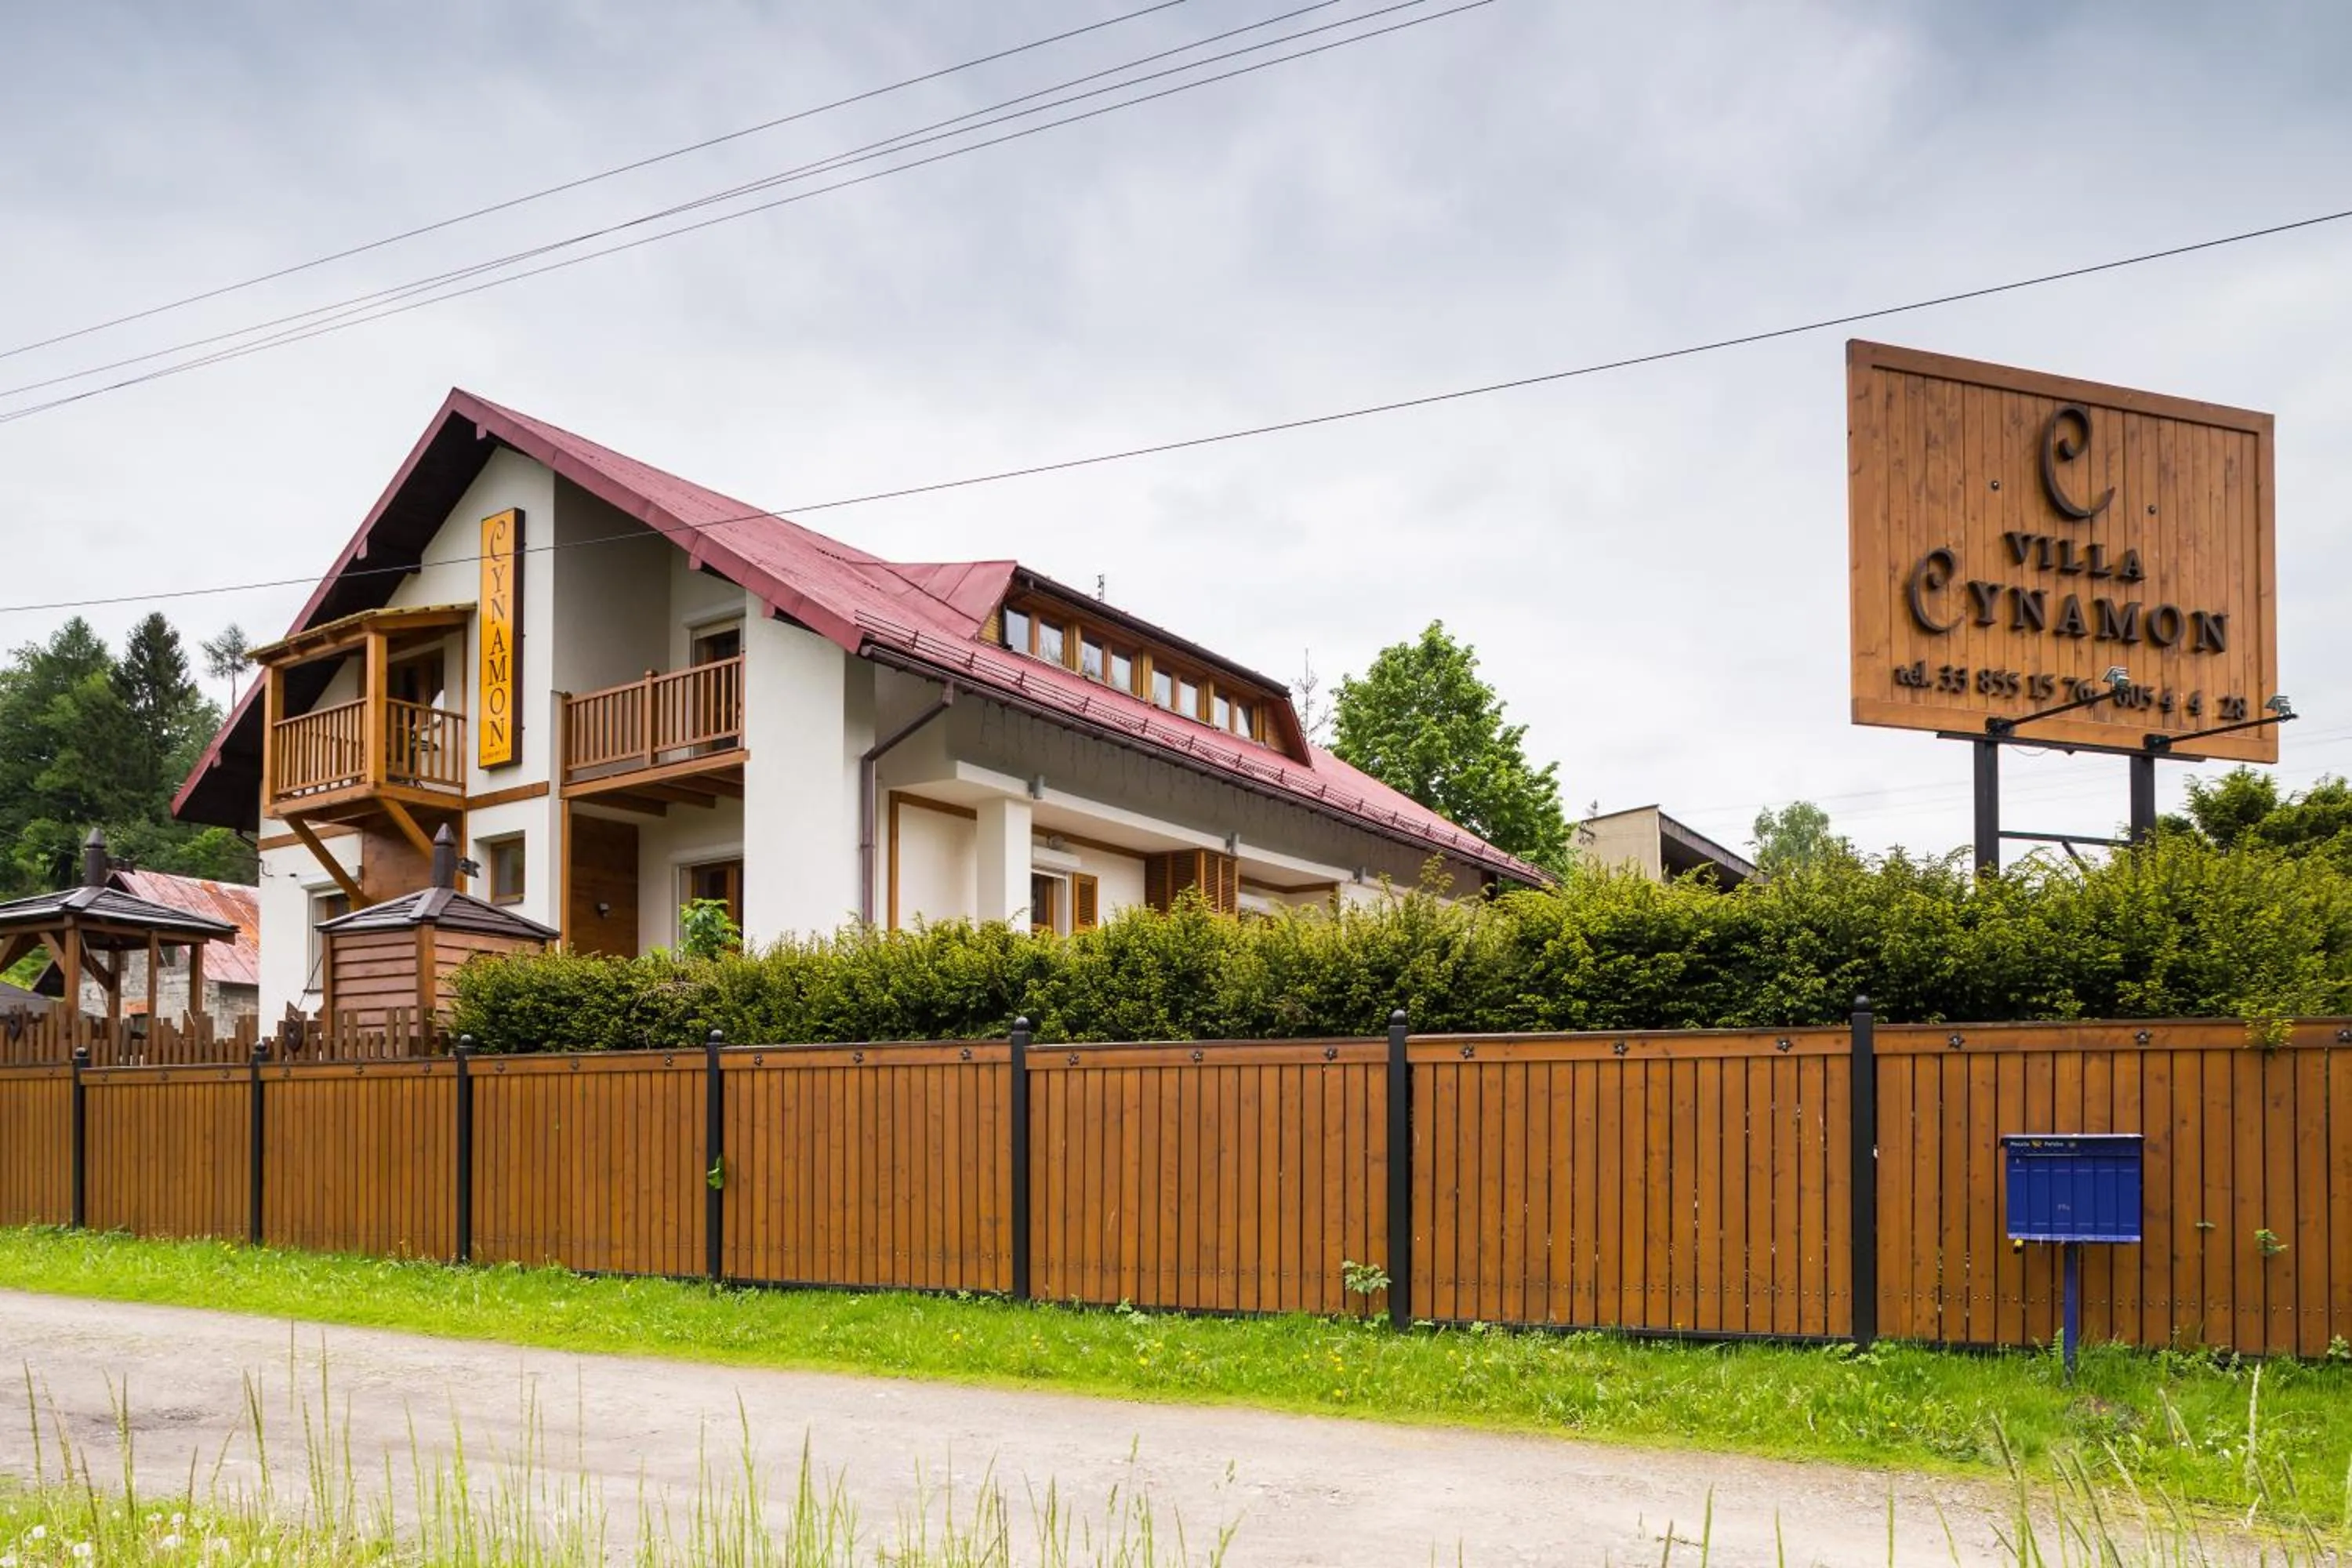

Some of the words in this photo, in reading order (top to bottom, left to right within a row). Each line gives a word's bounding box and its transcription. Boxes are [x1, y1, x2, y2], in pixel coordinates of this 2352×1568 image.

[2005, 532, 2145, 581] VILLA
[488, 520, 507, 747] CYNAMON
[1907, 548, 2230, 654] CYNAMON
[1894, 661, 1931, 688] tel.
[1937, 665, 1968, 695] 33
[1976, 669, 2020, 699] 855
[2027, 673, 2055, 701] 15
[2217, 695, 2247, 720] 28
